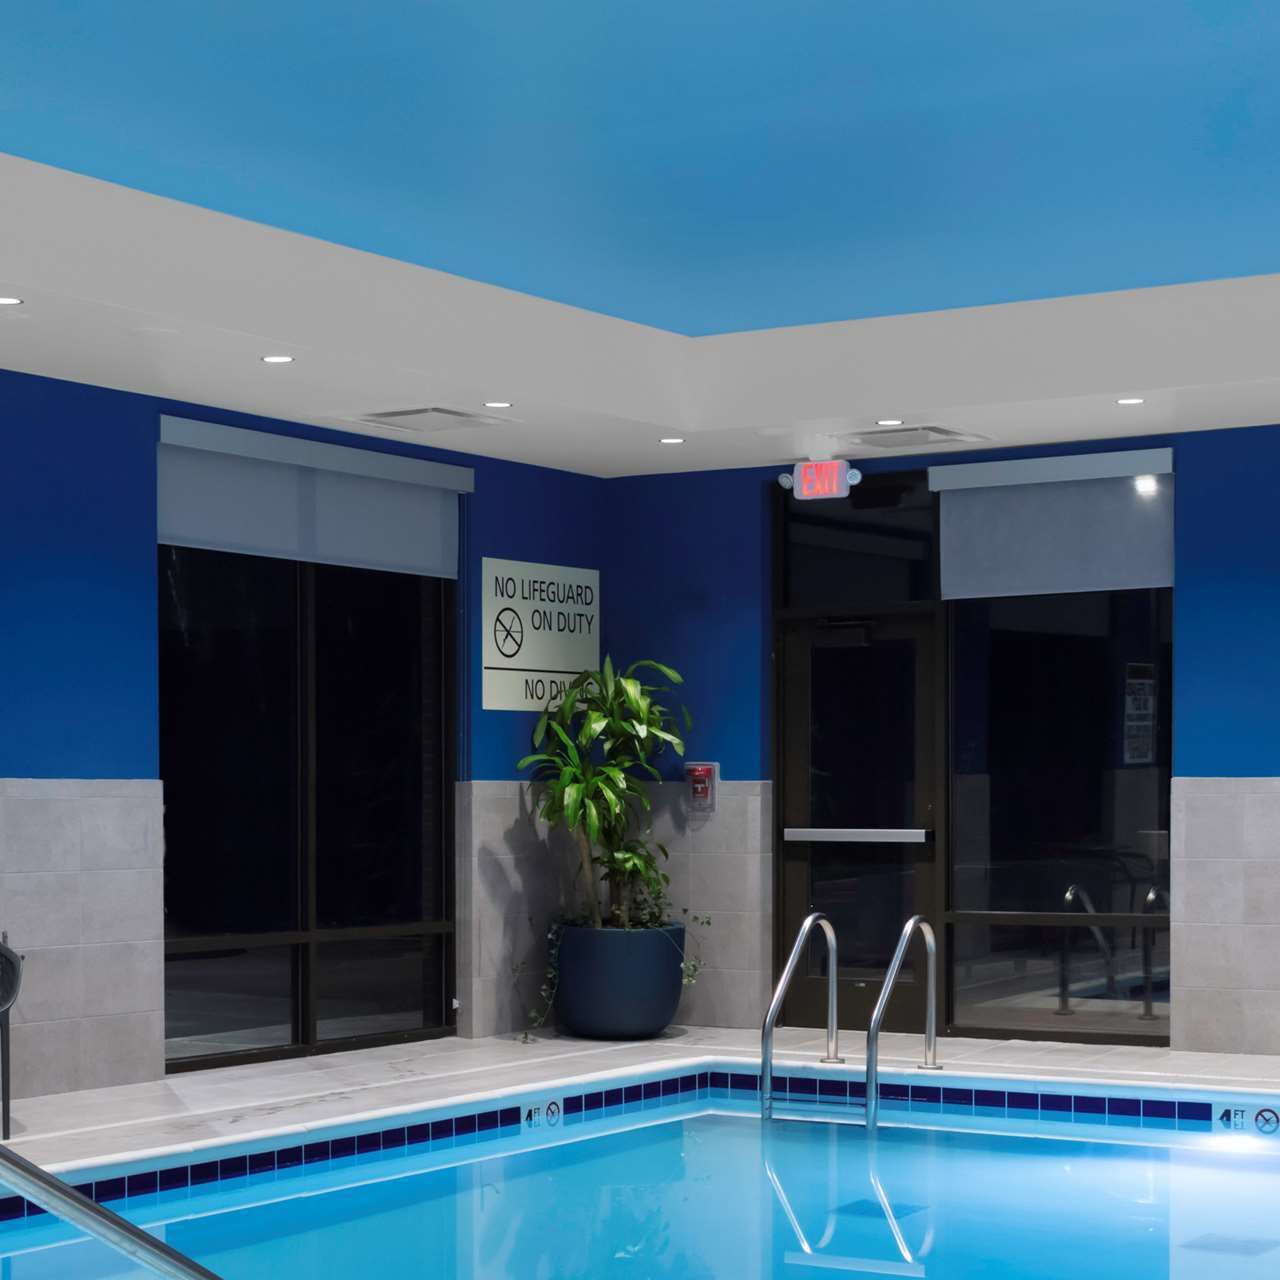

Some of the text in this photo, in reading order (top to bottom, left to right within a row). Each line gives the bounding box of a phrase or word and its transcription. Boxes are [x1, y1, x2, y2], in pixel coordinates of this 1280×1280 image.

[802, 462, 840, 497] EXIT
[494, 575, 594, 606] NO LIFEGUARD
[531, 609, 595, 635] ON DUTY
[524, 679, 545, 700] NO
